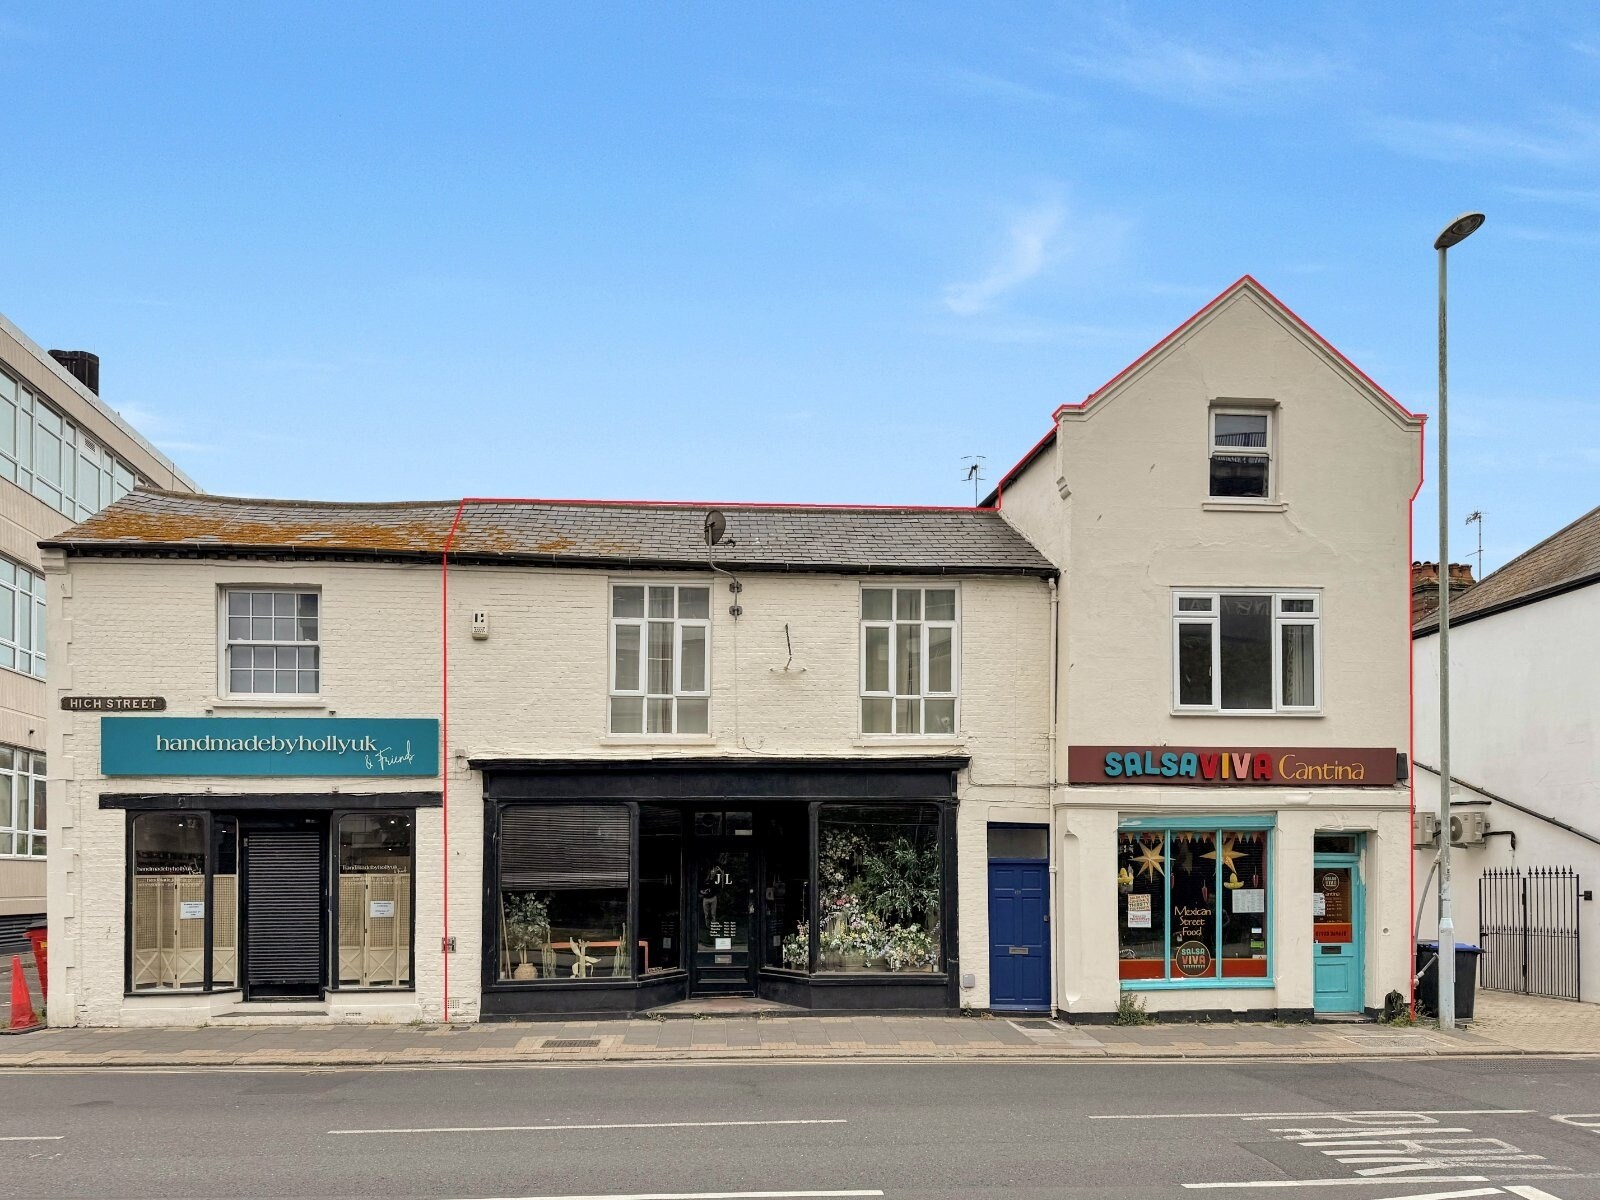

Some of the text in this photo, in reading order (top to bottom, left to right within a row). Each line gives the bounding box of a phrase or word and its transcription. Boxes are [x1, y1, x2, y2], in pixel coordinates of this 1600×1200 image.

[106, 698, 156, 709] STREET
[155, 734, 378, 755] handmadebyhollyuk
[1278, 754, 1366, 781] Cantina
[1174, 905, 1212, 916] Mexican
[1179, 915, 1206, 926] Street
[1182, 926, 1203, 937] Food
[1181, 947, 1206, 956] SALSA
[1181, 955, 1206, 965] VIVA
